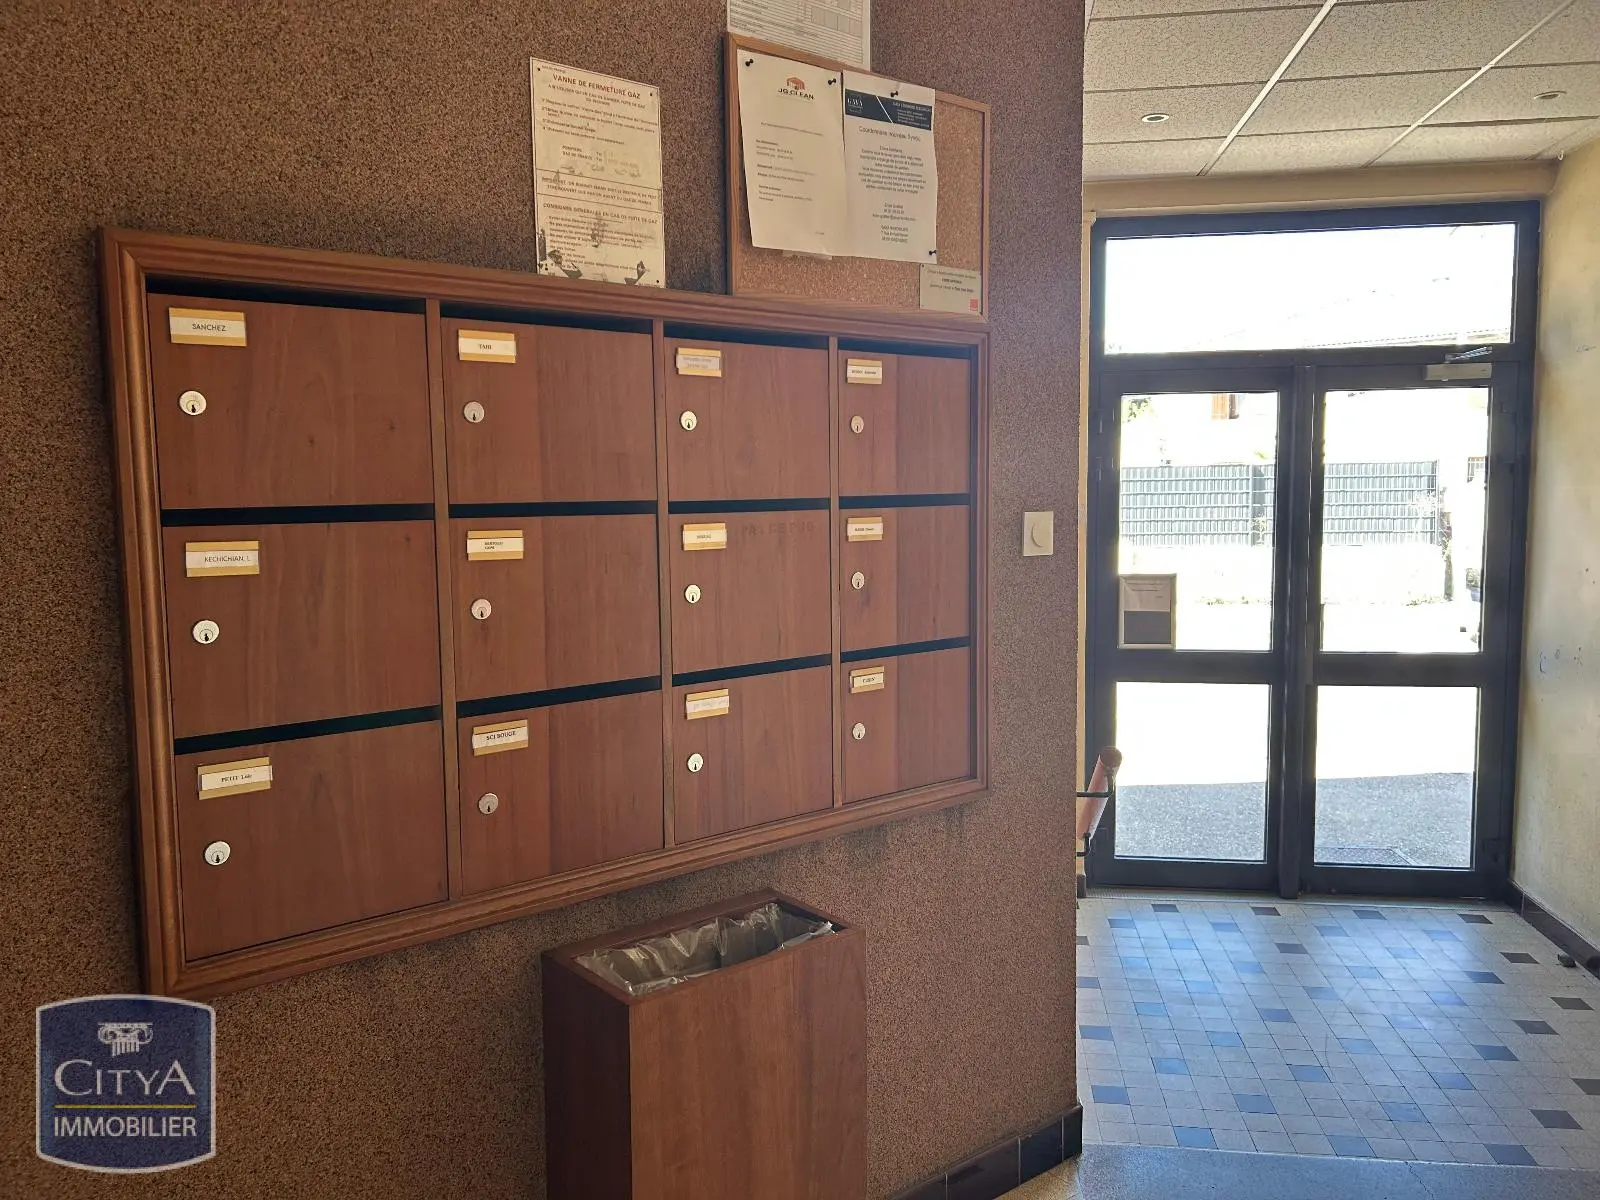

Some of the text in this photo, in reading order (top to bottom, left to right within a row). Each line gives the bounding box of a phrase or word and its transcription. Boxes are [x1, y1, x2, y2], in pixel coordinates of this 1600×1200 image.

[552, 74, 577, 85] VANNE
[578, 79, 587, 88] DE
[588, 82, 627, 96] FERMETURE
[627, 91, 641, 99] GAZ
[192, 323, 227, 332] SANCHEZ
[204, 555, 244, 563] KECHICHIAN
